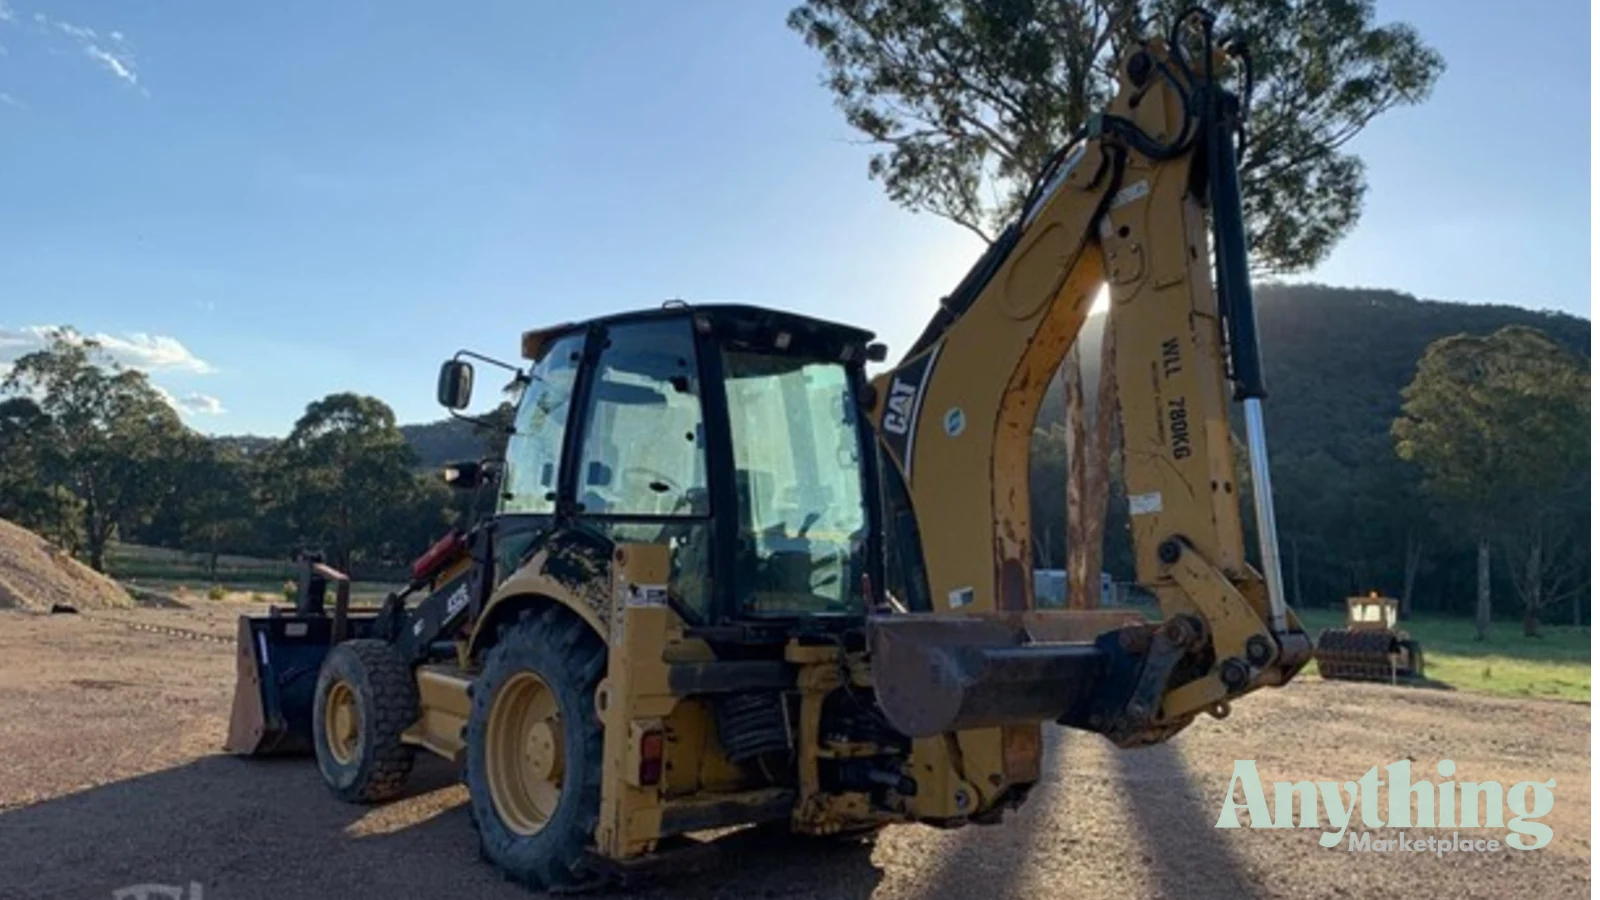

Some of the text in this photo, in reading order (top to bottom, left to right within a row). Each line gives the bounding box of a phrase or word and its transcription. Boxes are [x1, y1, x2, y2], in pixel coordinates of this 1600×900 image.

[883, 378, 917, 435] CAT
[1162, 338, 1192, 460] WLL 780KG
